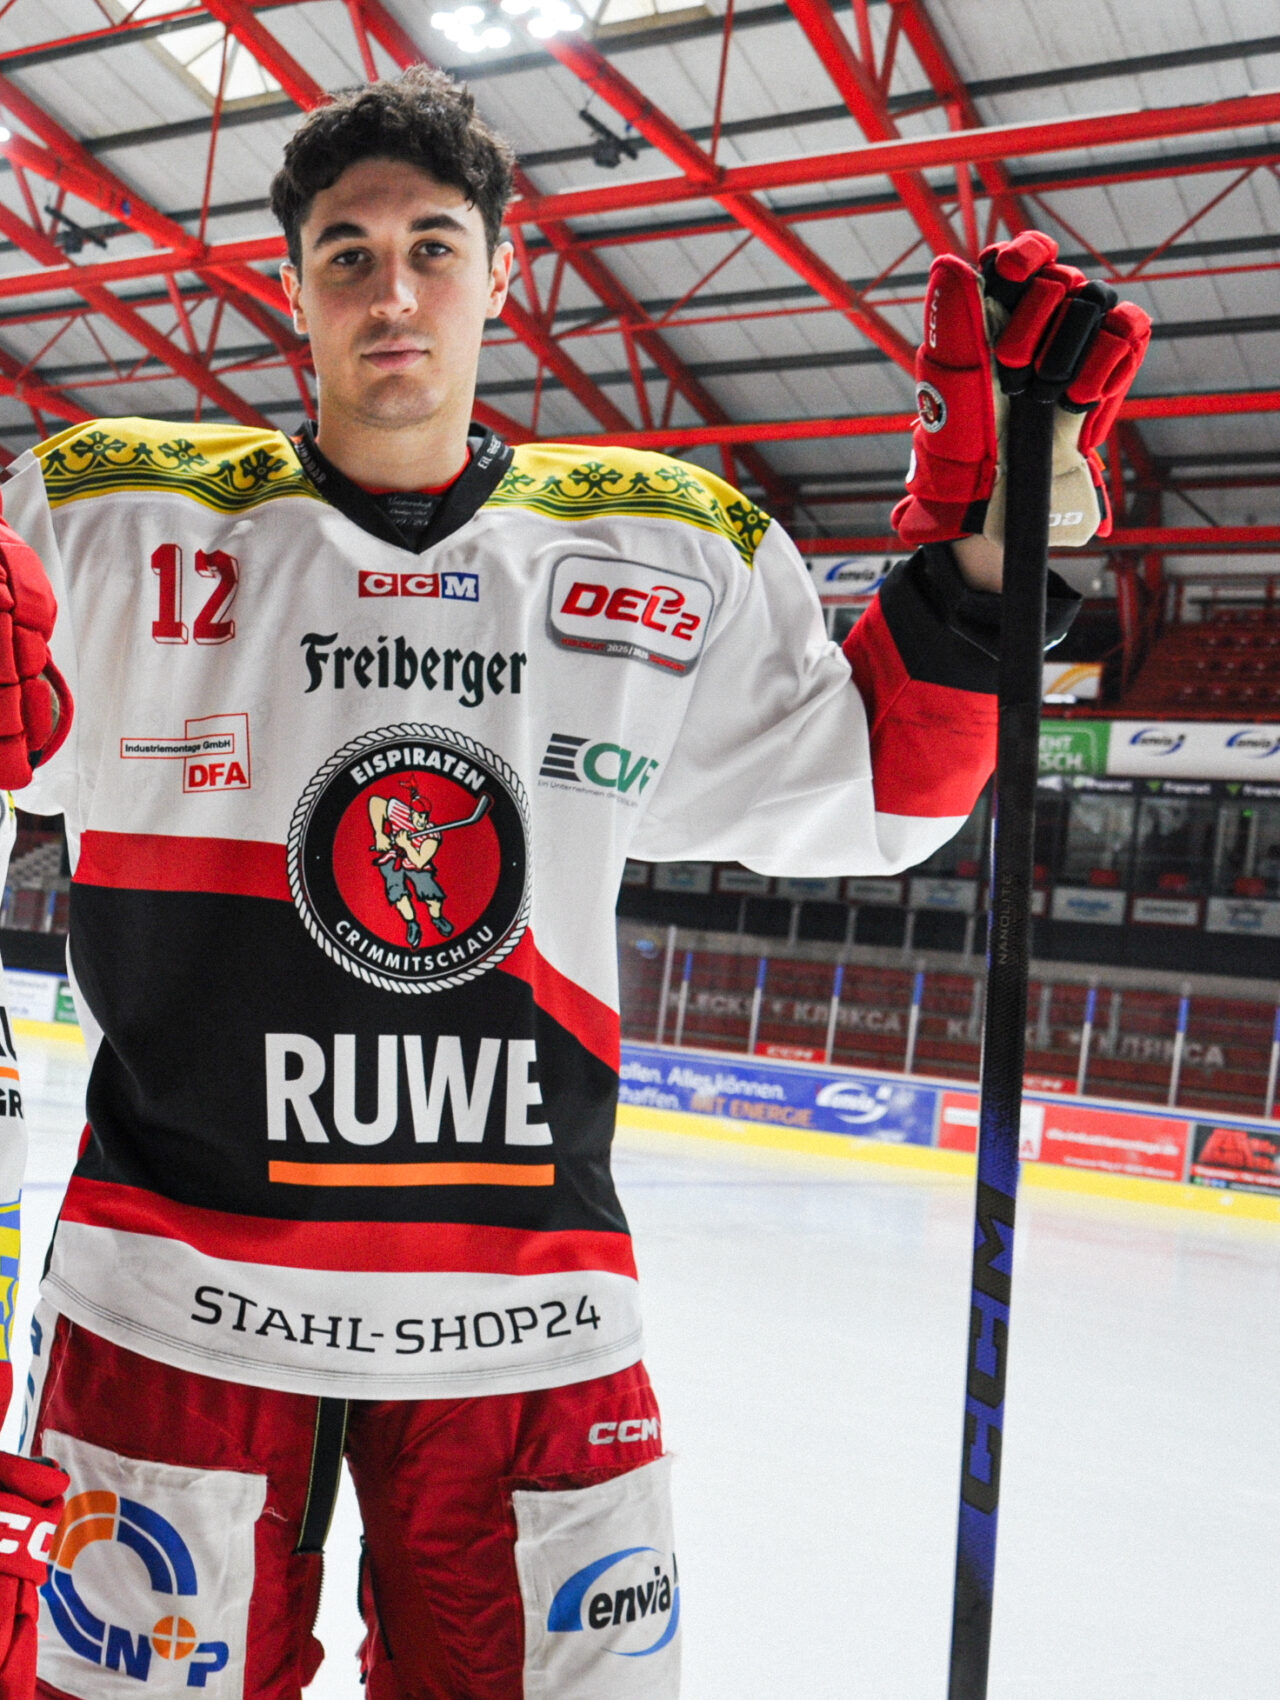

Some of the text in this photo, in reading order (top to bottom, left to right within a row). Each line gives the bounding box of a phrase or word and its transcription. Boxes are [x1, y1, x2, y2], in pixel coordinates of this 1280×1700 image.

[150, 543, 240, 645] 12
[362, 572, 478, 601] CCM
[300, 632, 528, 708] Freiberger
[125, 739, 231, 753] Industriemontage GmbH
[188, 761, 248, 788] DFA
[349, 748, 486, 791] EISPIRATEN
[335, 920, 494, 971] CRIMMITSCHAU
[265, 1033, 554, 1146] RUWE
[190, 1285, 601, 1355] STAHL-SHOP24
[961, 1180, 1016, 1516] CCM
[588, 1417, 661, 1445] CCM
[588, 1566, 671, 1630] envia
